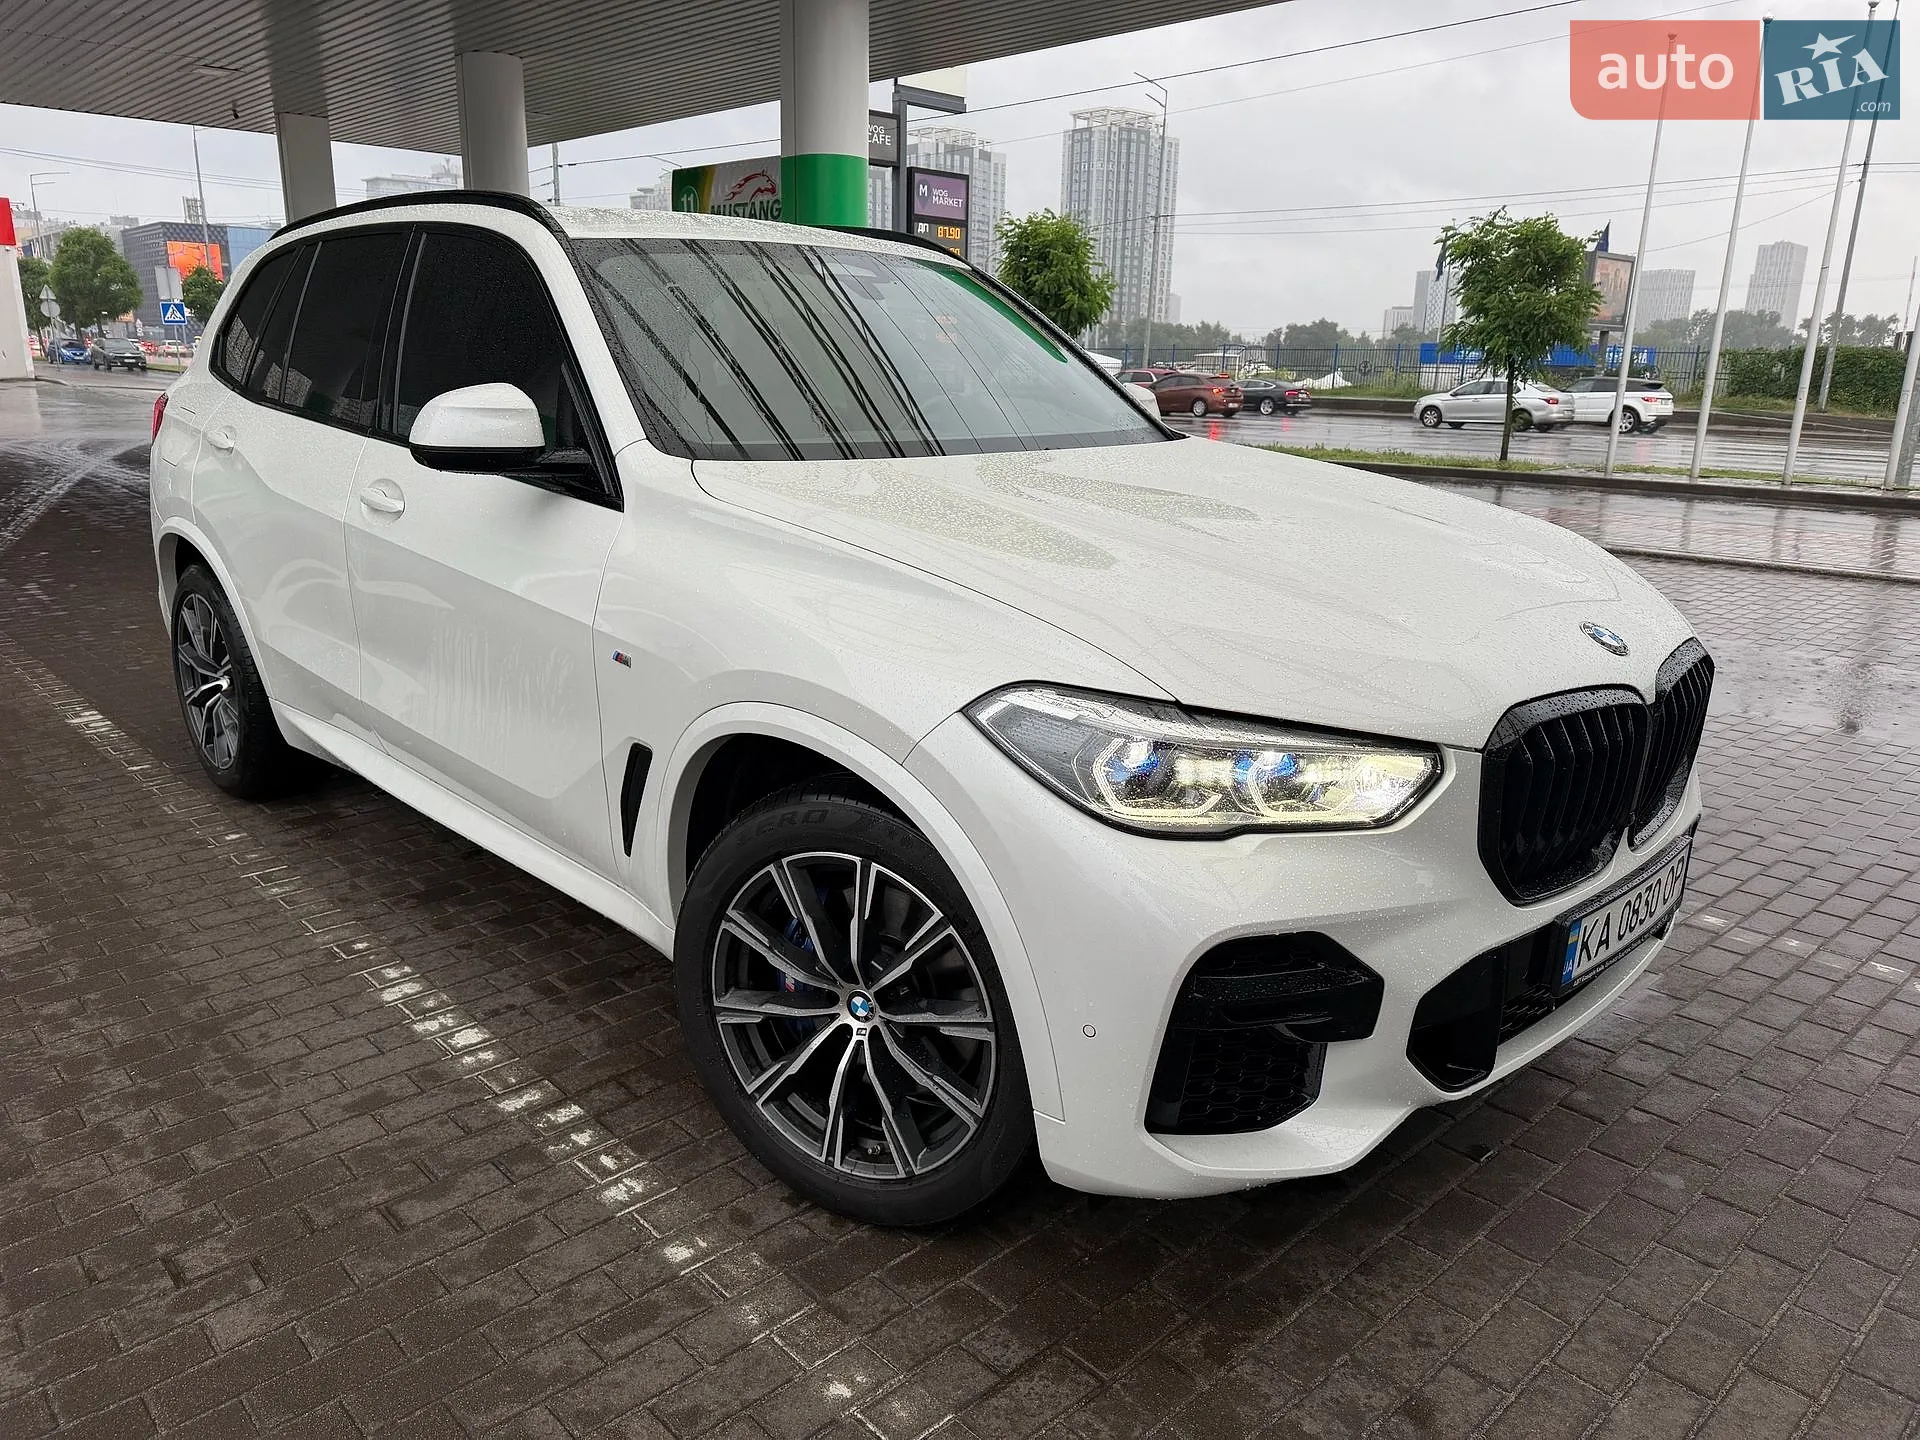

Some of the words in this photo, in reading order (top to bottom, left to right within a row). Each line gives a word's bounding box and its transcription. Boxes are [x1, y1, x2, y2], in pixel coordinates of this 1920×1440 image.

[932, 188, 949, 197] WOG
[710, 198, 782, 220] MUSTANG
[932, 196, 964, 208] MARKET
[1576, 911, 1611, 969] KA
[1617, 877, 1662, 941] 0830
